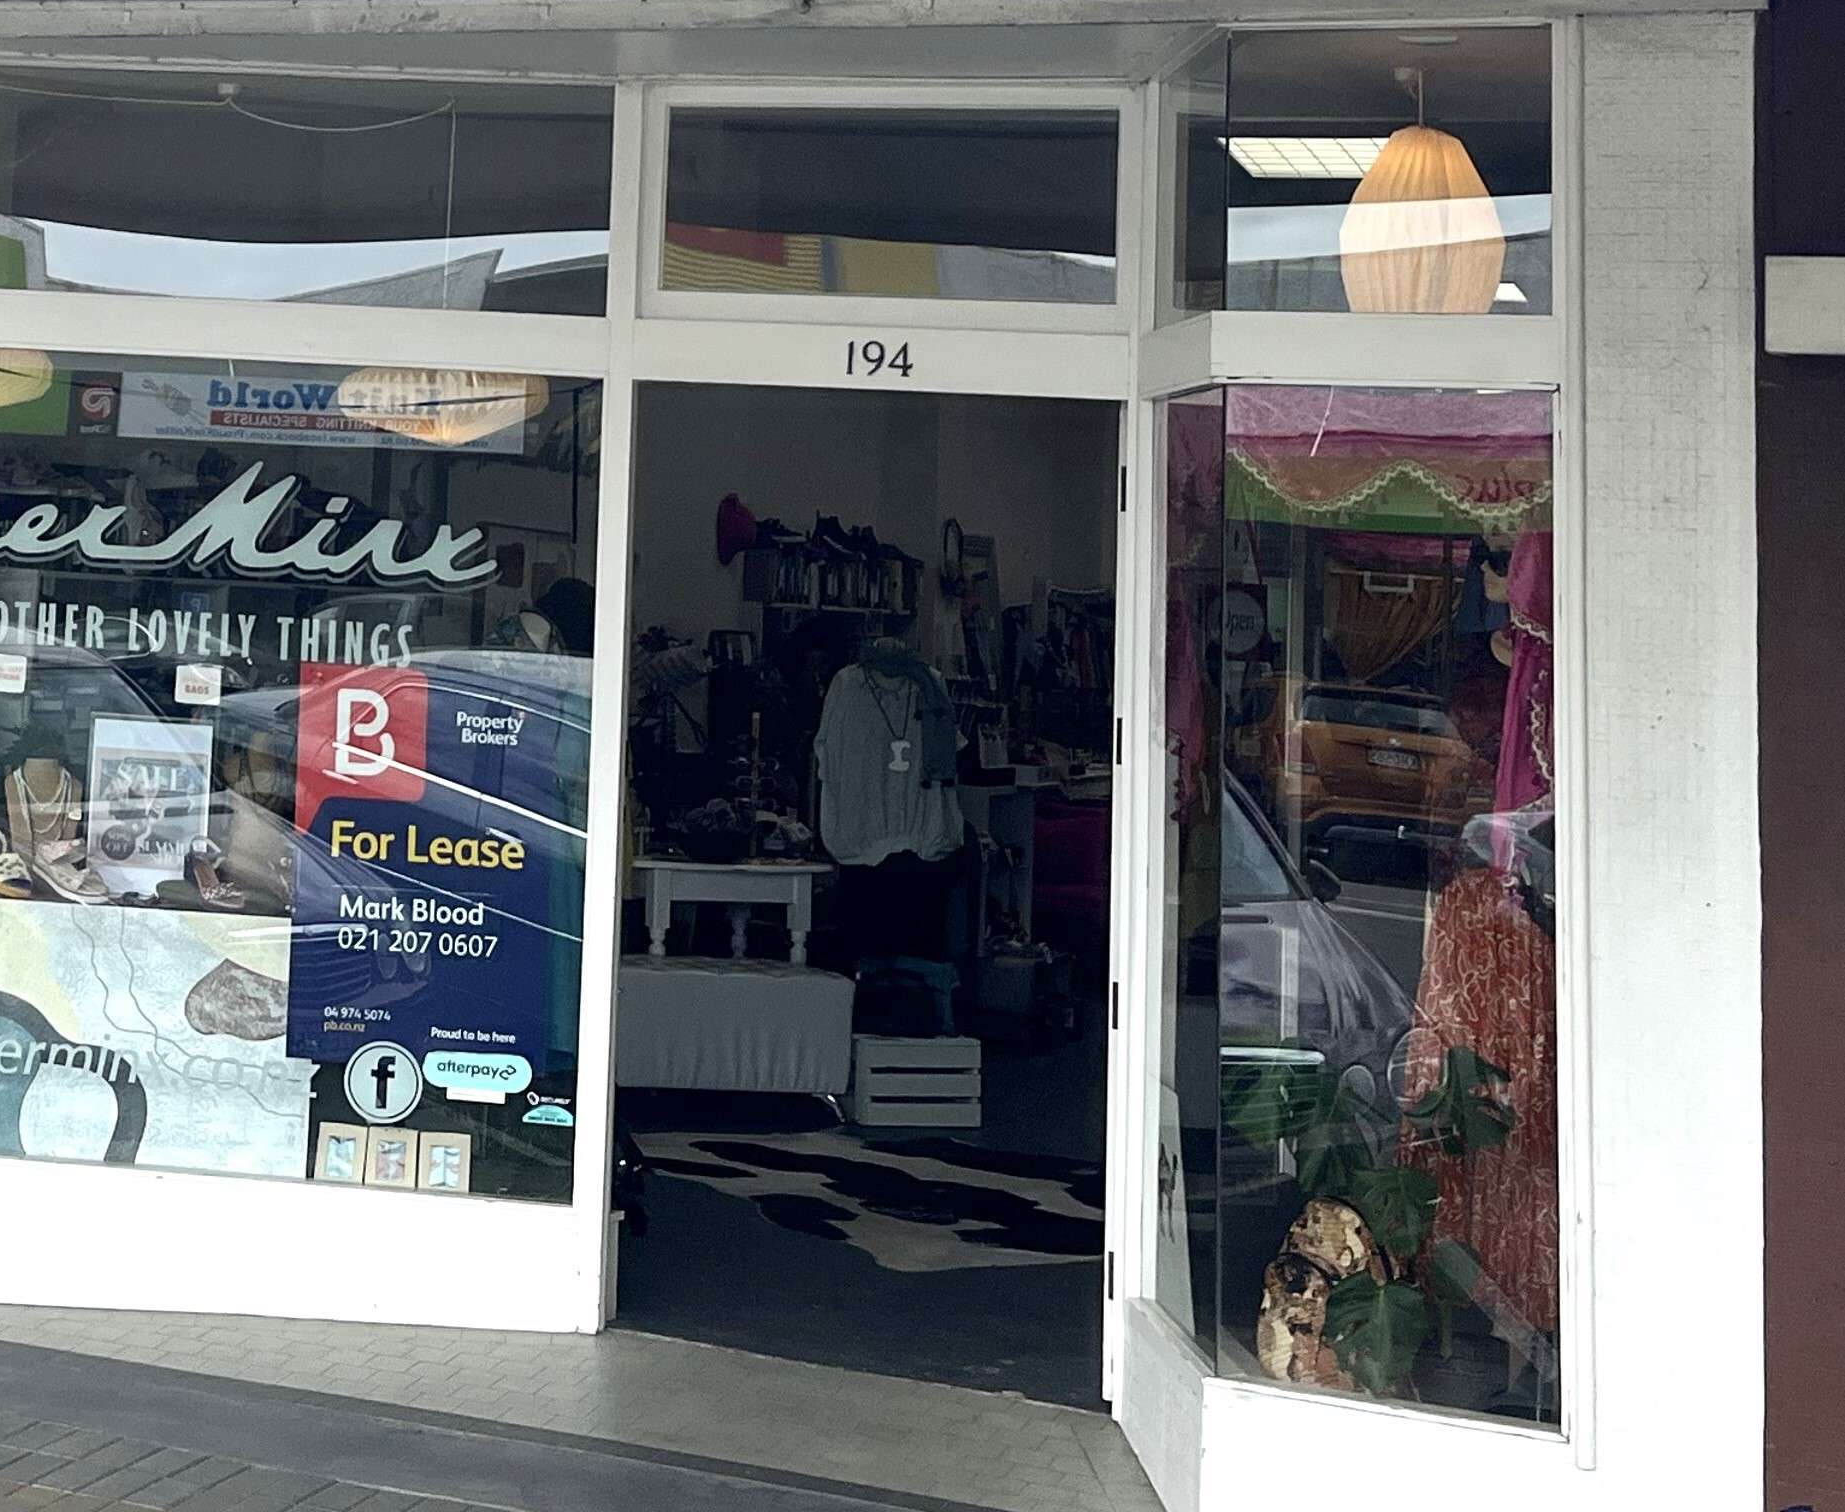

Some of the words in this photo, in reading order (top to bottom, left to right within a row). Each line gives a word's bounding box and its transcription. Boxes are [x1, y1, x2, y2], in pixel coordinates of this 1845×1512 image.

[845, 337, 913, 379] 194
[128, 606, 257, 659] LOVELY
[276, 615, 413, 669] THINGS
[456, 711, 525, 734] Property
[461, 728, 519, 747] Brokers
[330, 819, 396, 861] For
[406, 823, 526, 870] Lease
[339, 894, 405, 922] Mark
[411, 898, 485, 926] Blood
[337, 926, 380, 952] 021
[388, 930, 433, 954] 207
[438, 934, 499, 959] 0607
[323, 1005, 338, 1019] 04
[341, 1006, 362, 1021] 974
[431, 1026, 462, 1041] Proud
[463, 1029, 475, 1041] to
[477, 1030, 490, 1043] be
[492, 1030, 517, 1045] here
[437, 1059, 500, 1080] afterpay
